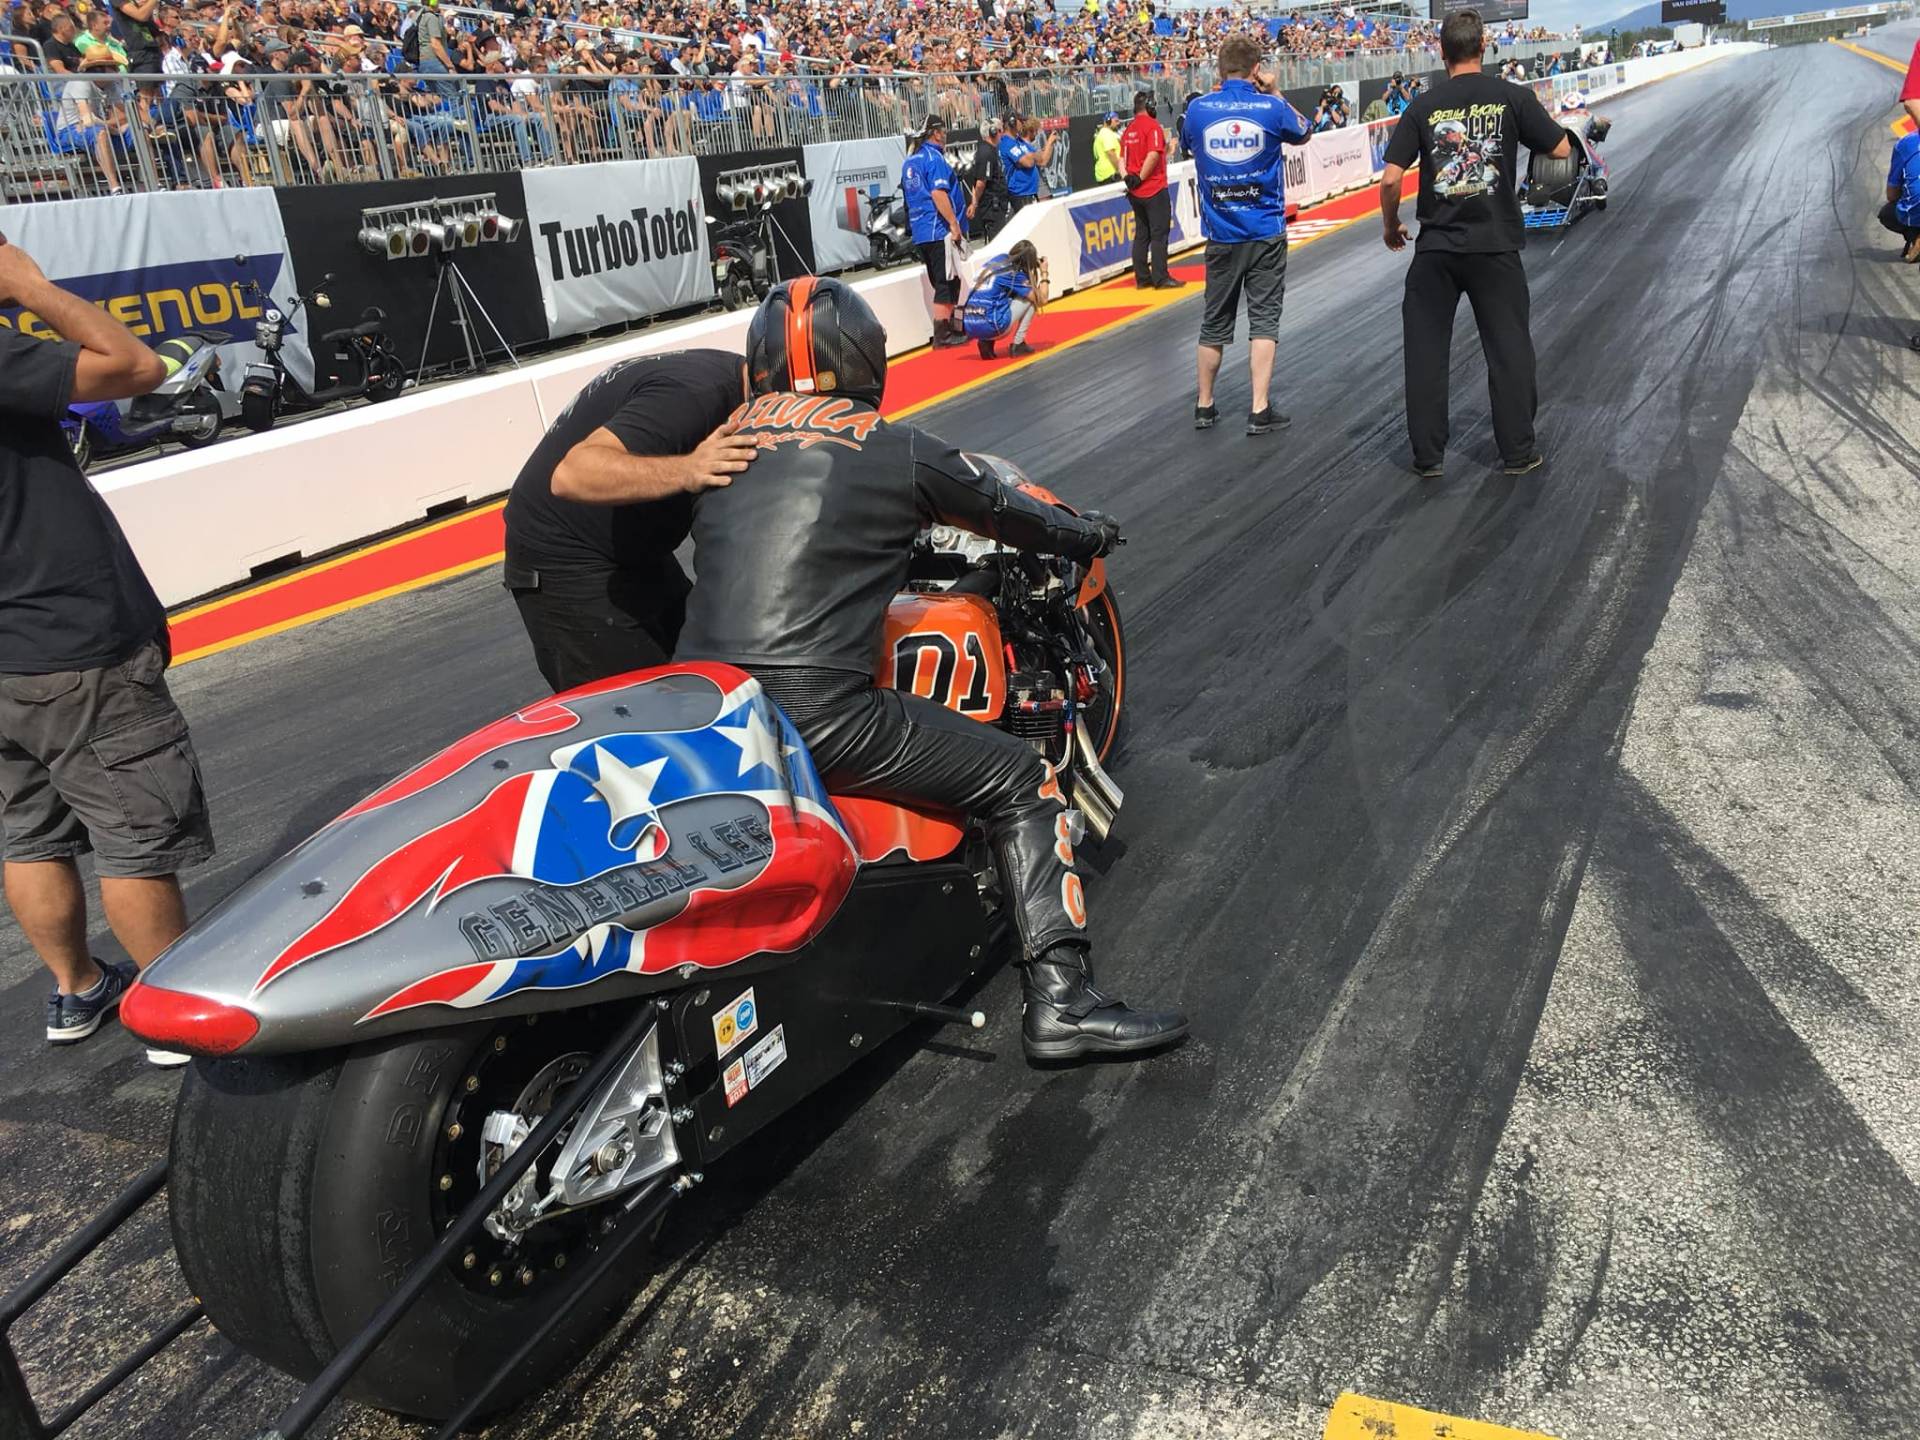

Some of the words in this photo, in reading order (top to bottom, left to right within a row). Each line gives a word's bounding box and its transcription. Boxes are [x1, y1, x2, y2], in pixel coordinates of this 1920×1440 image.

[836, 170, 885, 184] CAMARO
[1209, 134, 1259, 149] eurol
[539, 199, 699, 281] TurboTotal
[0, 279, 262, 342] ENOL
[893, 631, 992, 715] 01
[458, 854, 707, 962] GENERAL
[687, 814, 775, 874] LEE
